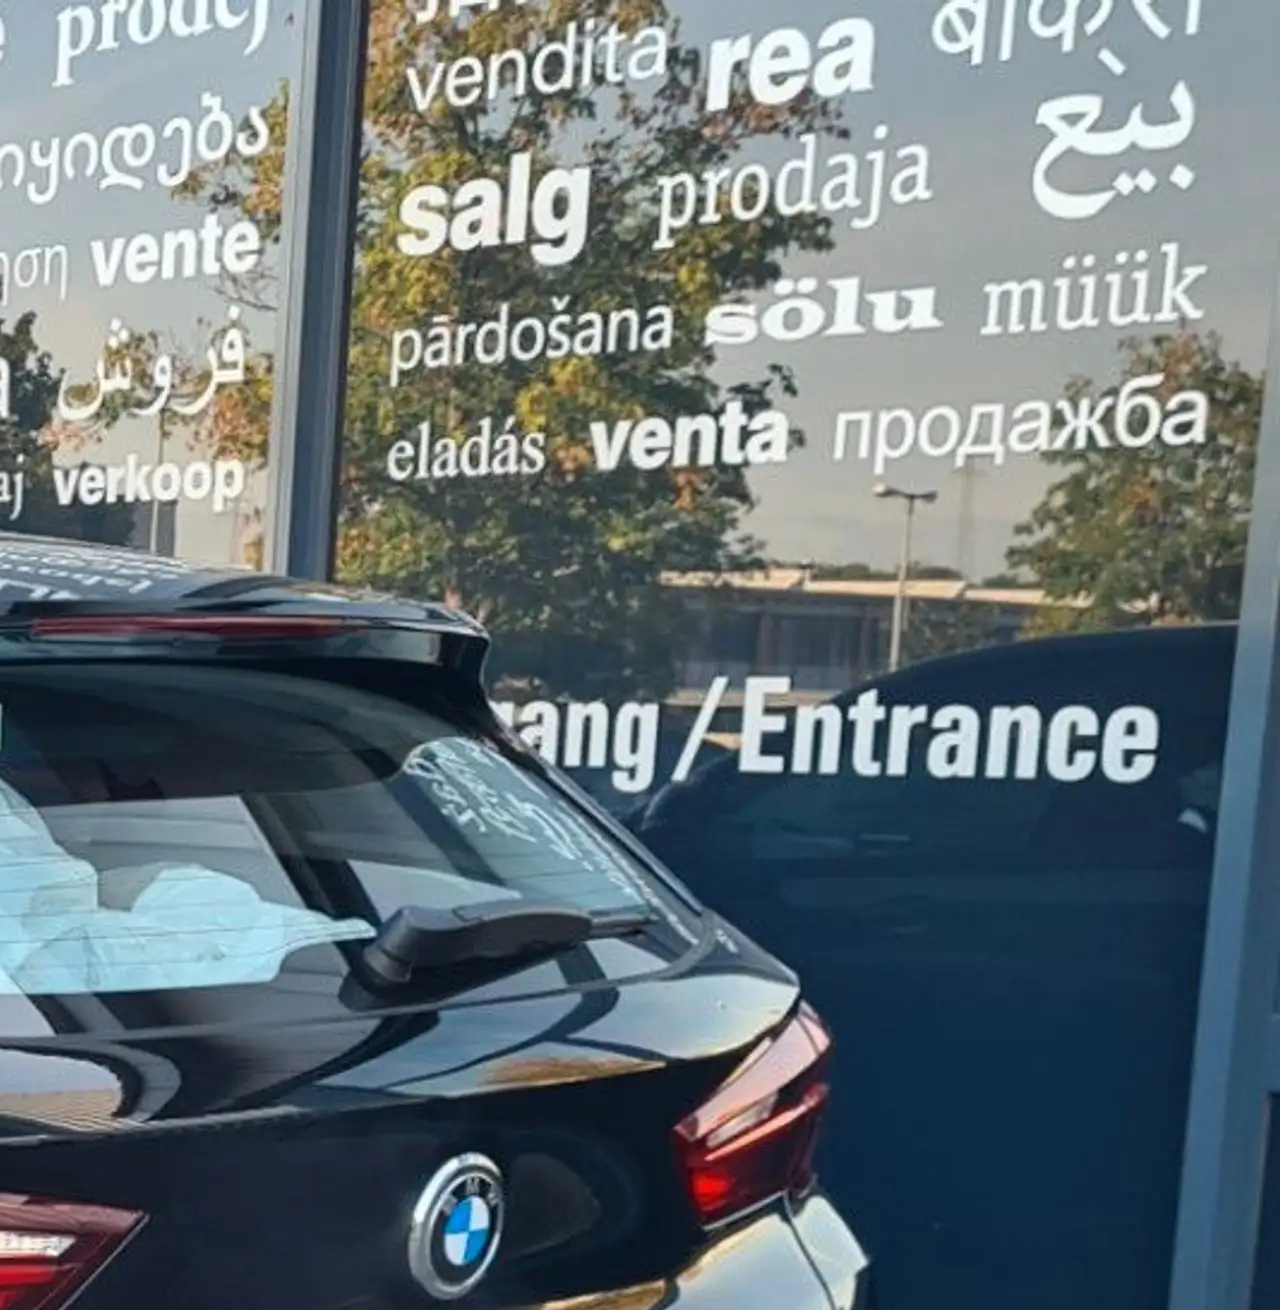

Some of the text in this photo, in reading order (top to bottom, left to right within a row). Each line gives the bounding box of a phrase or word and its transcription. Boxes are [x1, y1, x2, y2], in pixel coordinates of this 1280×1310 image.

[406, 18, 668, 112] vendita
[705, 17, 874, 112] rea
[396, 125, 933, 266] salg prodaja
[1032, 79, 1196, 220] بيع
[90, 213, 261, 288] vente
[57, 305, 245, 422] فروش
[389, 242, 1209, 387] pārdošana sölu müük
[387, 401, 789, 481] eladás venta
[833, 373, 1209, 475] продажба
[52, 453, 245, 513] verkoop
[490, 698, 659, 793] ang
[738, 676, 1160, 780] Entrance
